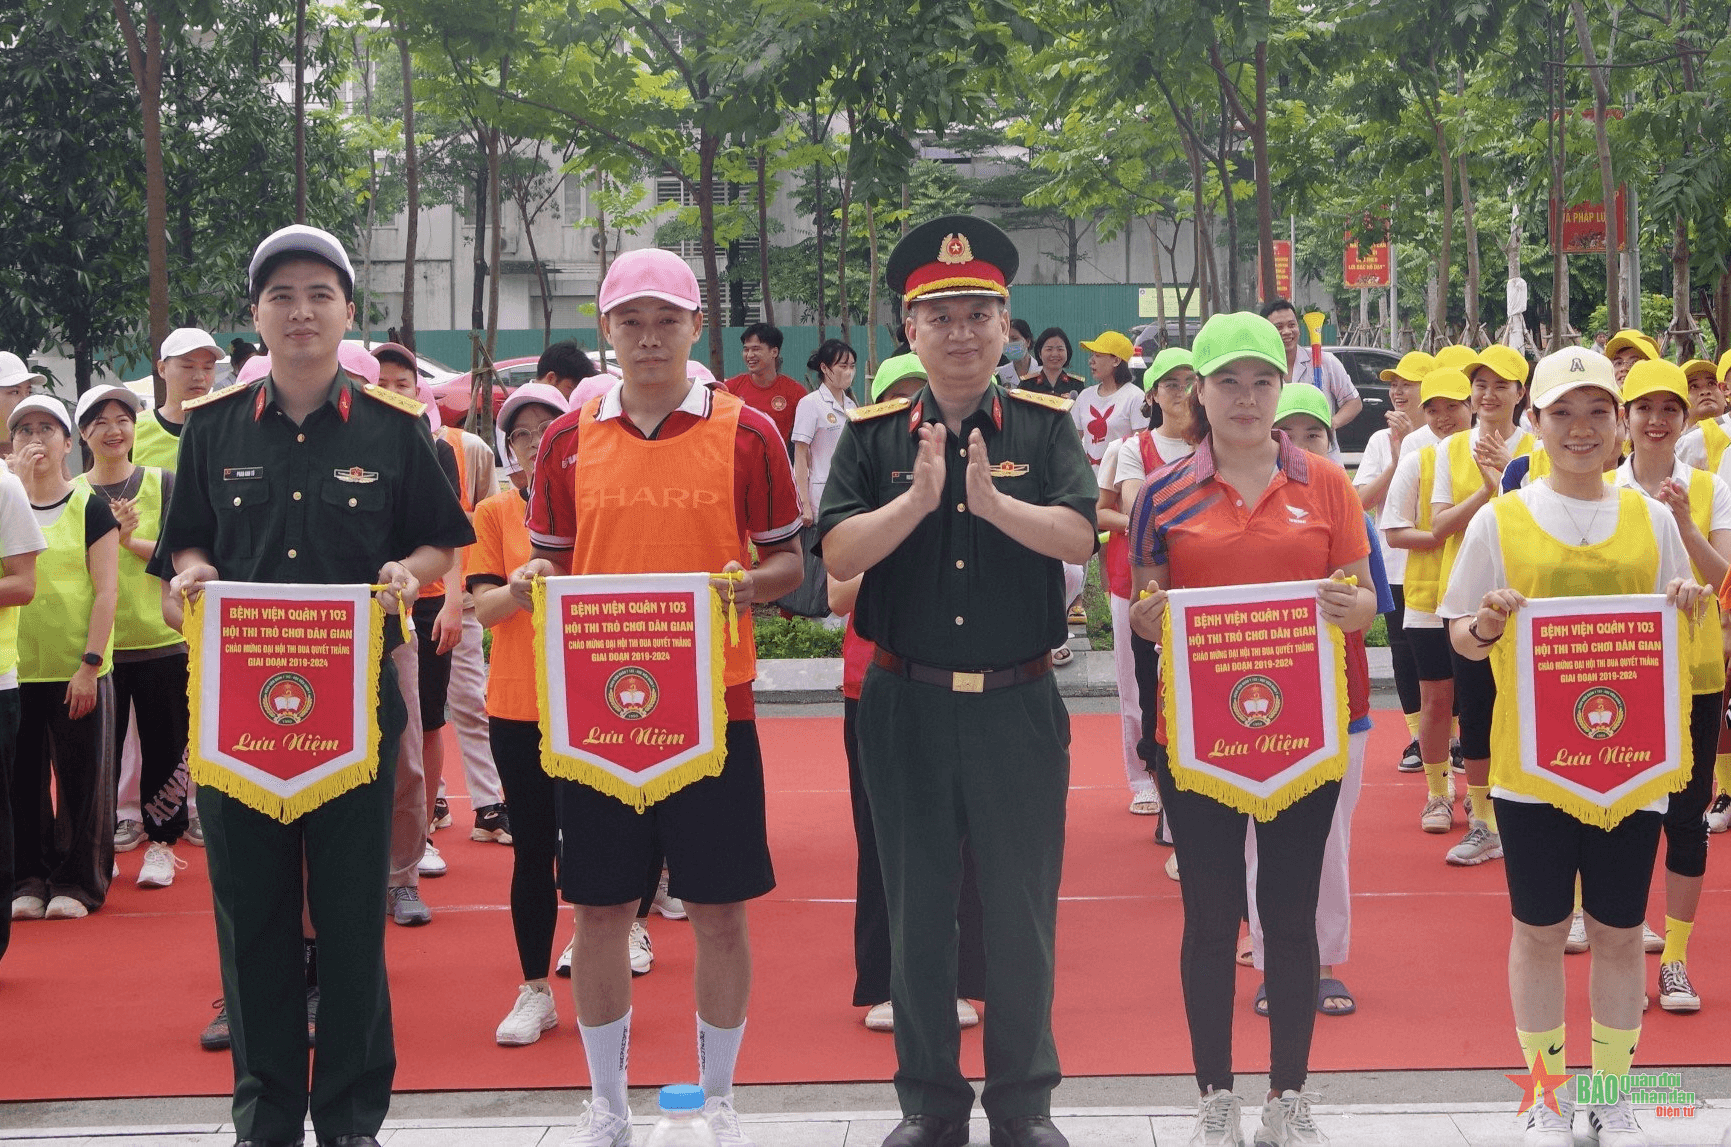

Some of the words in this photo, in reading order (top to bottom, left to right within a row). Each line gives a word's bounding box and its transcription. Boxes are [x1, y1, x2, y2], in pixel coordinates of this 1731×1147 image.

[1570, 358, 1585, 372] A
[580, 485, 720, 511] SHARP
[230, 605, 258, 620] BỆNH
[262, 606, 285, 621] VIỆN
[289, 607, 317, 621] QUÂN
[320, 610, 327, 621] Y
[330, 610, 346, 621] 103
[571, 602, 599, 617] BỆNH
[602, 601, 625, 616] VIỆN
[629, 600, 657, 613] QUÂN
[660, 602, 666, 613] Y
[669, 602, 686, 613] 103
[1194, 613, 1221, 628] BỆNH
[1224, 611, 1247, 626] VIỆN
[1251, 608, 1280, 622] QUÂN
[1283, 610, 1289, 621] Y
[1292, 608, 1308, 619] 103
[223, 625, 239, 639] HỘI
[242, 628, 257, 637] THI
[261, 626, 279, 638] TRÒ
[282, 627, 304, 638] CHƠI
[307, 626, 327, 639] DÂN
[330, 629, 352, 639] GIAN
[565, 622, 581, 635] HỘI
[584, 623, 599, 633] THI
[602, 621, 620, 632] TRÒ
[623, 622, 645, 632] CHƠI
[649, 620, 668, 631] DÂN
[671, 621, 693, 631] GIAN
[1541, 623, 1568, 639] BỆNH
[1571, 621, 1594, 637] VIỆN
[1597, 620, 1625, 634] QUÂN
[1628, 622, 1634, 633] Y
[1637, 622, 1654, 632] 103
[569, 639, 584, 649] CHÀO
[617, 639, 627, 649] HỘI
[629, 639, 638, 647] THI
[653, 636, 670, 648] QUYẾT
[1189, 634, 1205, 647] HỘI
[1208, 634, 1222, 644] THI
[1225, 631, 1242, 642] TRÒ
[1246, 630, 1268, 641] CHƠI
[1271, 627, 1290, 639] DÂN
[1293, 626, 1316, 637] GIAN
[226, 642, 241, 653] CHÀO
[275, 643, 285, 655] HỘI
[287, 645, 296, 653] THI
[311, 644, 329, 655] QUYẾT
[1193, 650, 1208, 661] CHÀO
[1240, 648, 1250, 658] HỘI
[1252, 648, 1260, 656] THI
[1276, 643, 1293, 655] QUYẾT
[1535, 644, 1550, 658] HỘI
[1553, 644, 1568, 654] THI
[1571, 641, 1588, 652] TRÒ
[1591, 642, 1613, 652] CHƠI
[1616, 639, 1635, 651] DÂN
[1638, 641, 1662, 650] GIAN
[248, 658, 263, 666] GIAI
[266, 658, 286, 669] ĐOẠN
[289, 658, 328, 667] 2019-2024
[592, 653, 607, 662] GIAI
[609, 653, 629, 663] ĐOẠN
[632, 652, 670, 661] 2019-2024
[1215, 663, 1230, 672] GIAI
[1232, 662, 1252, 672] ĐOẠN
[1255, 658, 1293, 669] 2019-2024
[1538, 660, 1554, 671] CHÀO
[1586, 659, 1595, 670] HỘI
[1597, 660, 1605, 668] THI
[1620, 656, 1638, 667] QUYẾT
[1561, 674, 1575, 683] GIAI
[1577, 673, 1597, 684] ĐOẠN
[1600, 671, 1637, 681] 2019-2024
[232, 733, 276, 751] Lưu
[283, 733, 339, 756] Niệm
[583, 727, 626, 745] Lưu
[630, 727, 685, 750] Niệm
[1208, 739, 1250, 758] Lưu
[1255, 734, 1310, 755] Niệm
[1550, 749, 1593, 767] Lưu
[1598, 746, 1651, 767] Niệm
